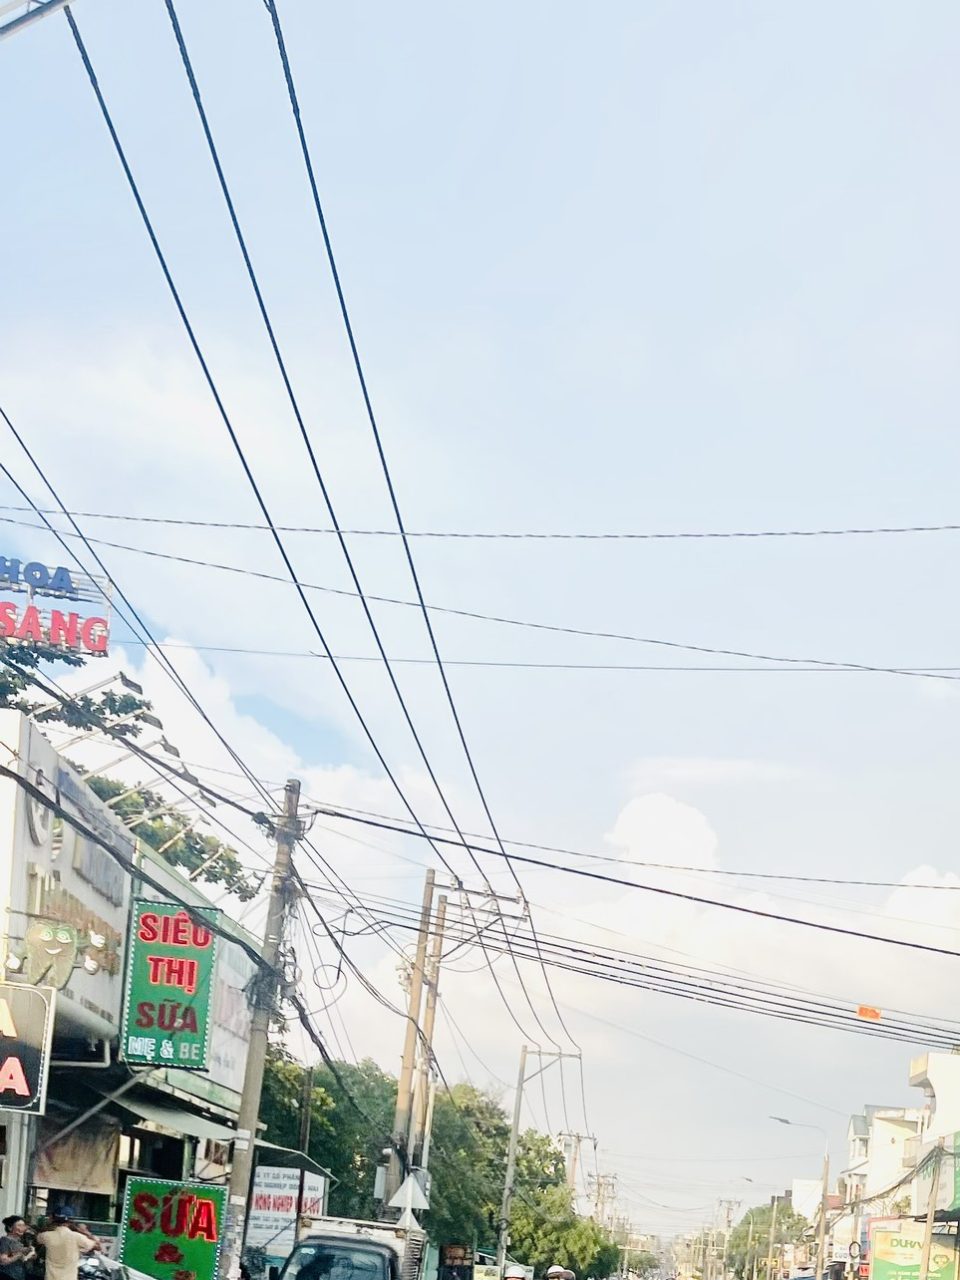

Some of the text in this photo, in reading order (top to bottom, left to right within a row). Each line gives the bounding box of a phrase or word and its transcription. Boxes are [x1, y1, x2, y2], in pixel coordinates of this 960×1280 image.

[0, 602, 108, 652] SANG
[138, 911, 213, 948] SIÊU
[148, 955, 198, 994] THỊ
[136, 998, 198, 1034] SỮA
